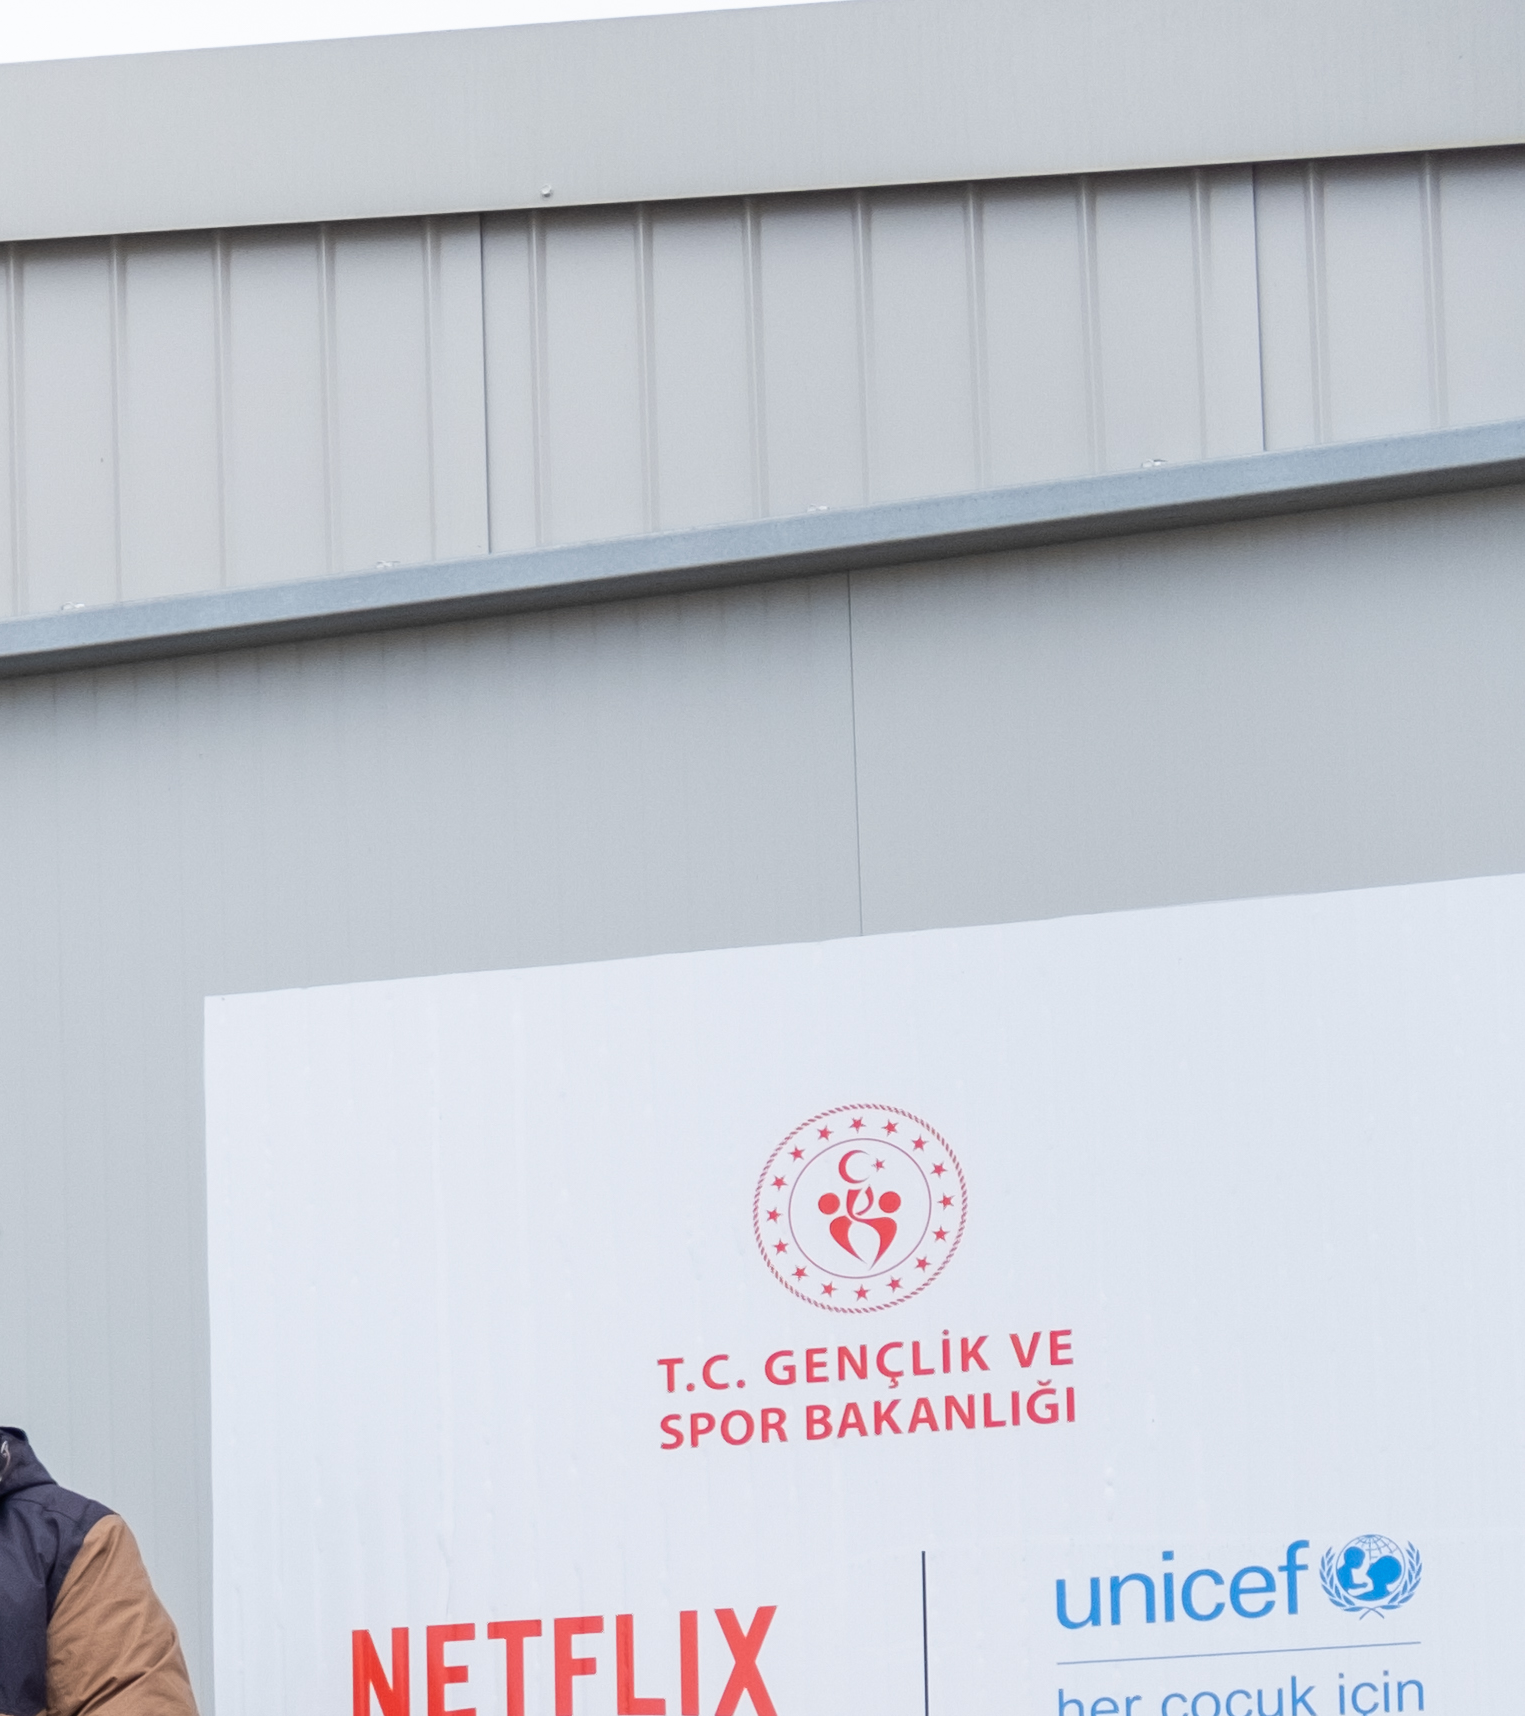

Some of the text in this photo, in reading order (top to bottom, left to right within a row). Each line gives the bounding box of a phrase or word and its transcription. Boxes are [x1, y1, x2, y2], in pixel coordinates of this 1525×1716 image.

[657, 1325, 1075, 1393] T.C. GENÇLİK VE
[660, 1379, 1077, 1450] SPOR BAKANLIĞI
[1055, 1538, 1310, 1631] unicef
